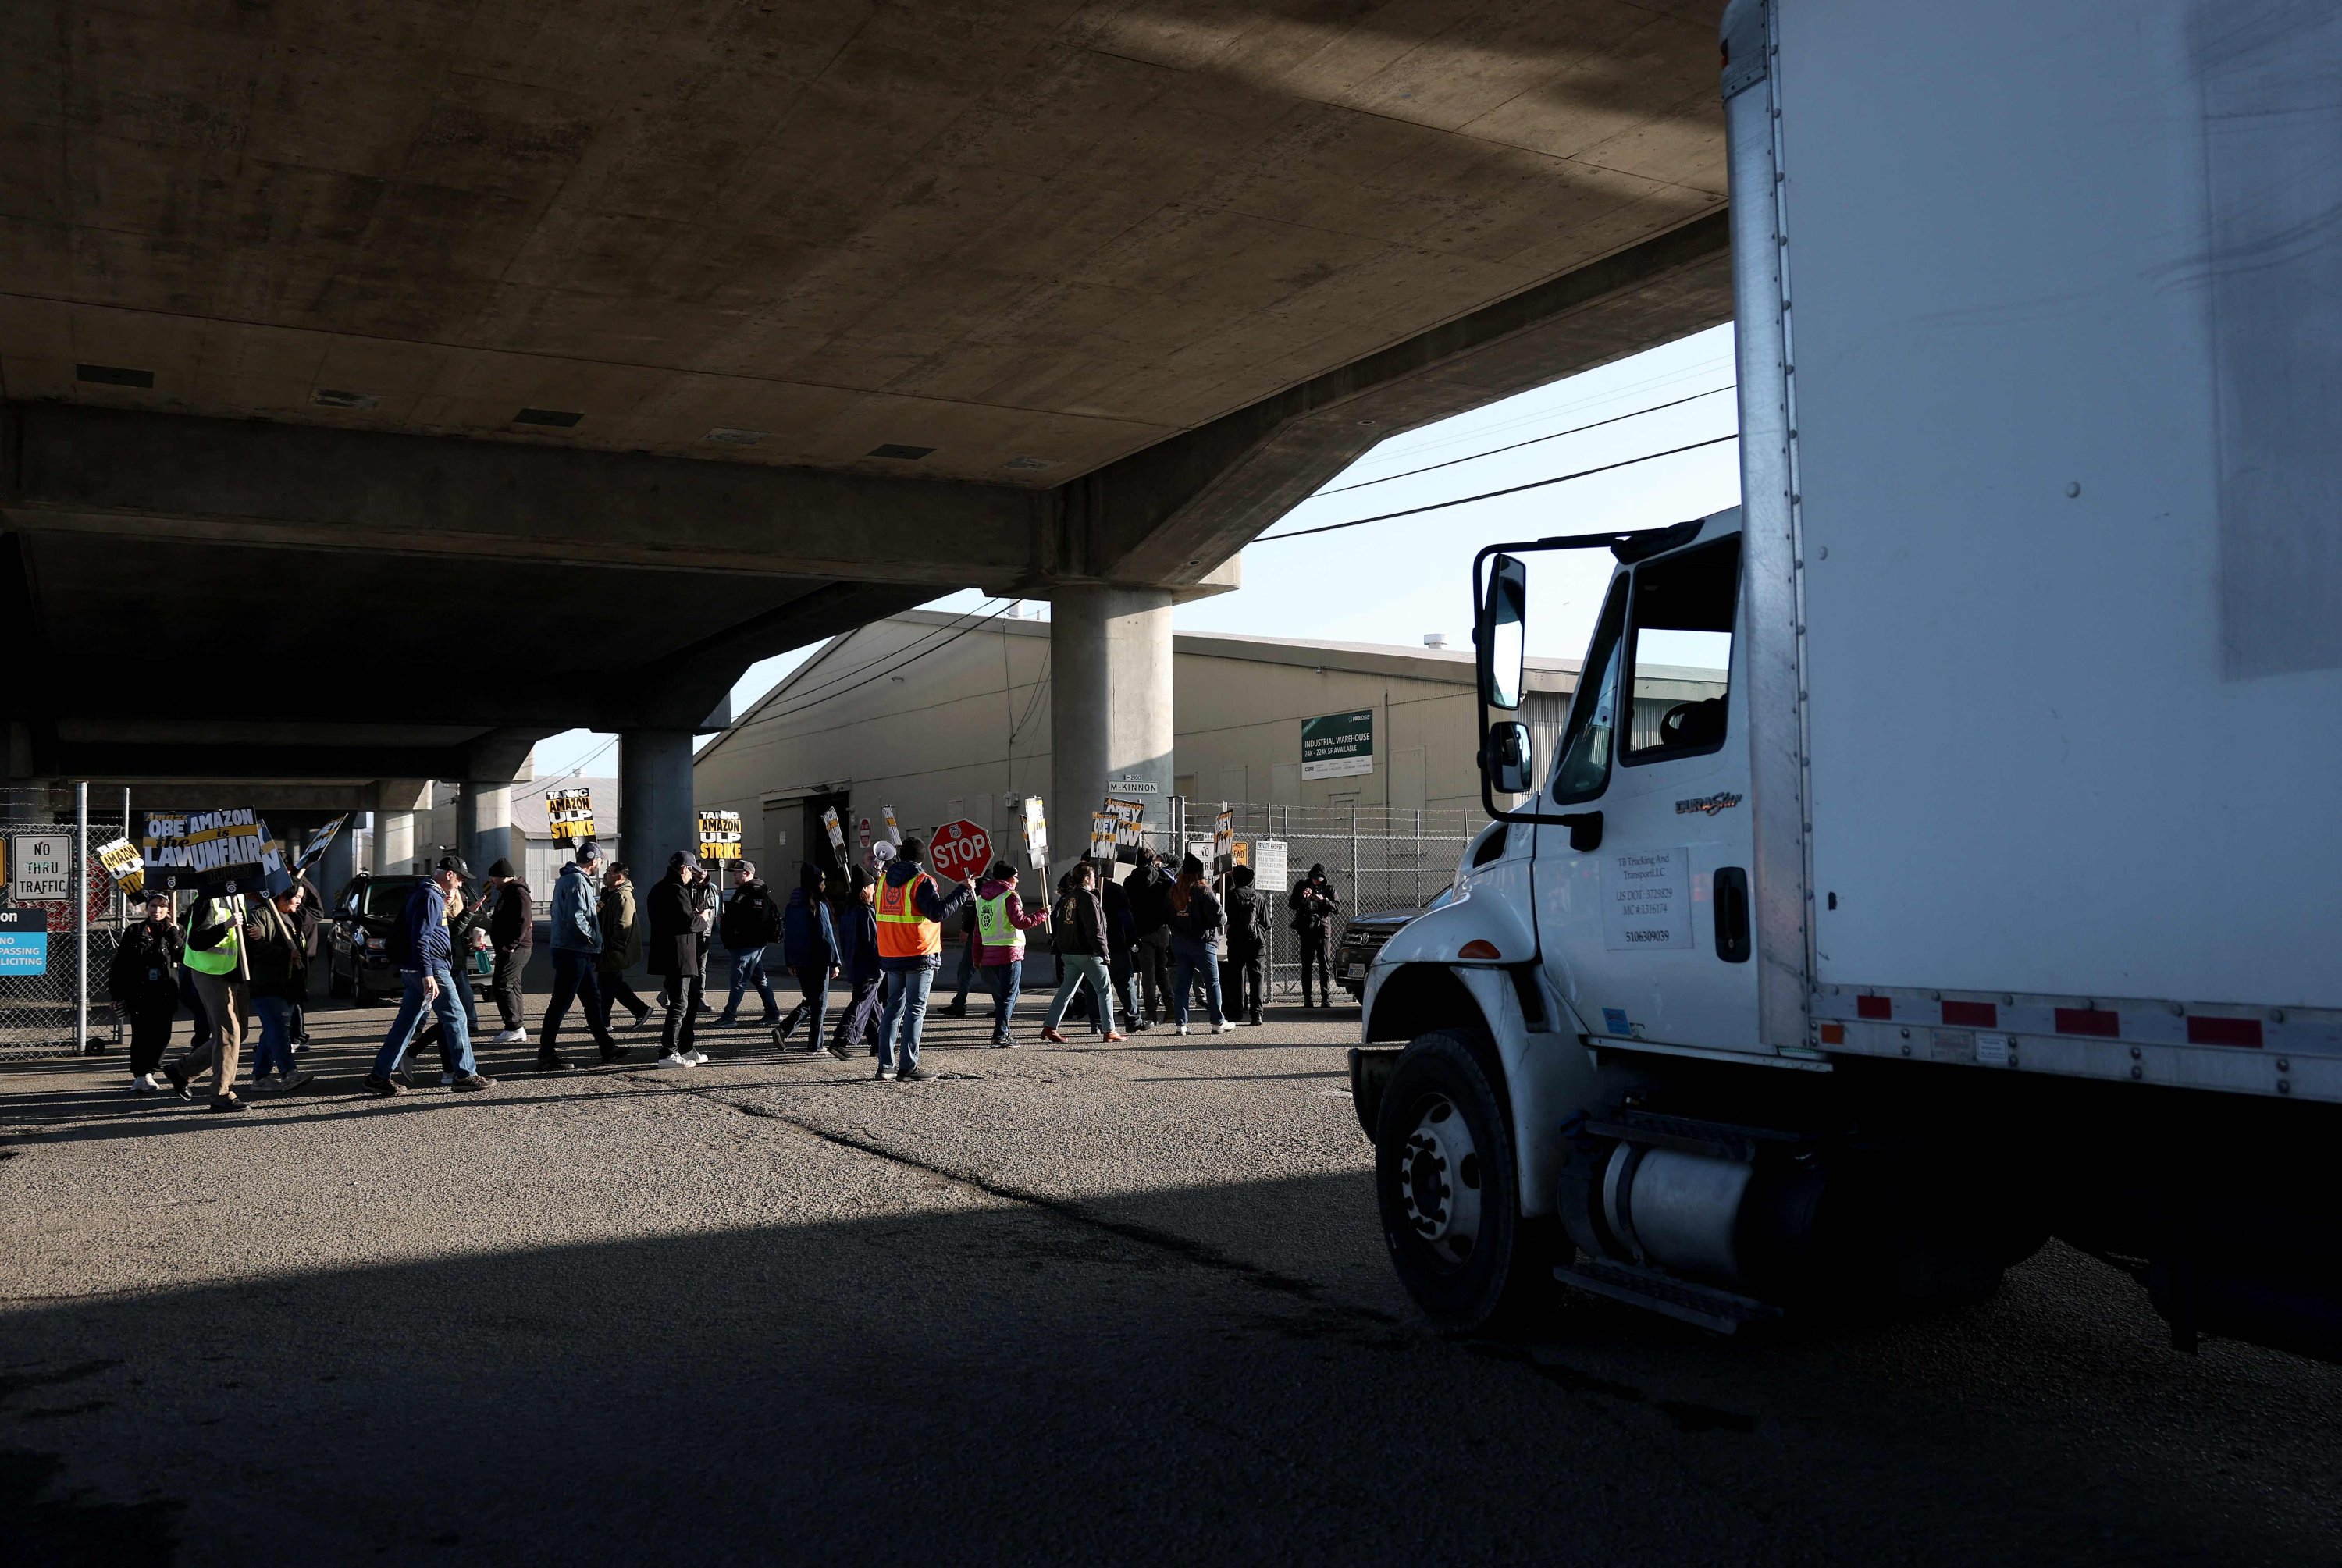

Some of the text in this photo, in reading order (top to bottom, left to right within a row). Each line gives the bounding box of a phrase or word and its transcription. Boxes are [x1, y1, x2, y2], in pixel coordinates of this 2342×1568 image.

[1304, 733, 1370, 748] INDUSTRIAL WAREHOUSE
[1333, 745, 1357, 753] AVAILABLE
[1110, 783, 1156, 792] McKINNON
[550, 797, 589, 812] AMAZON
[548, 809, 593, 823] ULP
[1105, 805, 1141, 823] OBEY
[190, 809, 254, 834] AMAZON
[702, 820, 740, 832] AMAZON
[1094, 819, 1116, 834] OBEY
[1215, 816, 1233, 833] OBEY
[148, 820, 187, 837] OBE
[216, 829, 230, 838] is
[550, 820, 596, 840] STRIKE
[156, 837, 190, 848] the
[699, 832, 742, 843] ULP
[1097, 831, 1111, 842] the
[1216, 830, 1229, 842] the
[34, 844, 51, 856] NO
[191, 835, 263, 872] UNFAIR
[700, 843, 742, 859] STRIKE
[934, 834, 986, 869] STOP
[1091, 841, 1116, 859] LAW
[1214, 837, 1233, 858] LAW
[104, 844, 138, 869] AMAZON
[1233, 850, 1244, 859] EAD
[1628, 855, 1655, 867] Trucking
[1657, 854, 1670, 863] And
[28, 862, 59, 874] THRU
[109, 858, 144, 880] ULP
[1205, 862, 1214, 871] RU
[20, 880, 66, 894] TRAFFIC
[1617, 891, 1626, 901] US
[1623, 905, 1635, 916] MC
[0, 912, 18, 923] on
[1625, 930, 1670, 943] 5106309039
